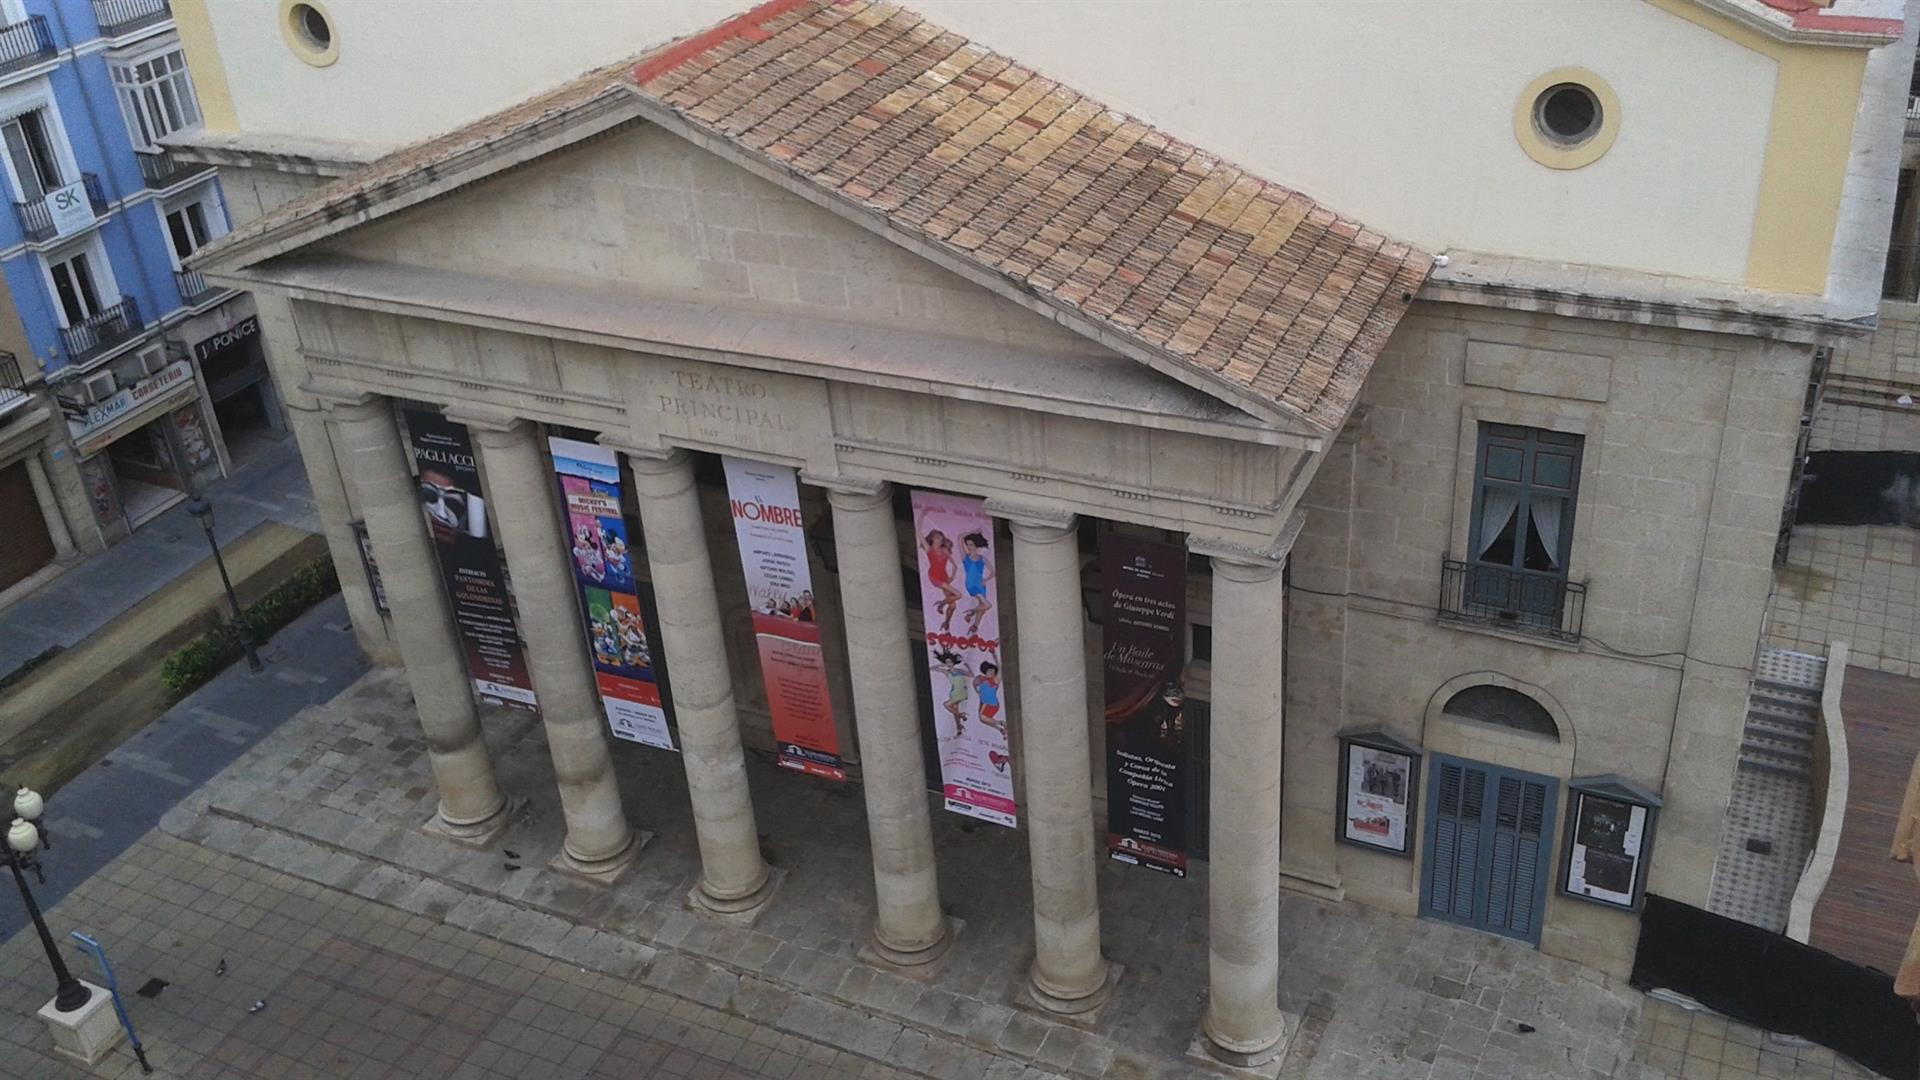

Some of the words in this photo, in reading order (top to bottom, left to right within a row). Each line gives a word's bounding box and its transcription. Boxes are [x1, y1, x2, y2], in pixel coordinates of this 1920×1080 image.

[55, 187, 80, 210] SK
[671, 370, 767, 399] TEATRO
[658, 395, 792, 431] PRINCIPAL
[413, 447, 476, 467] PAGLIACCI
[730, 499, 803, 528] NOMBRE
